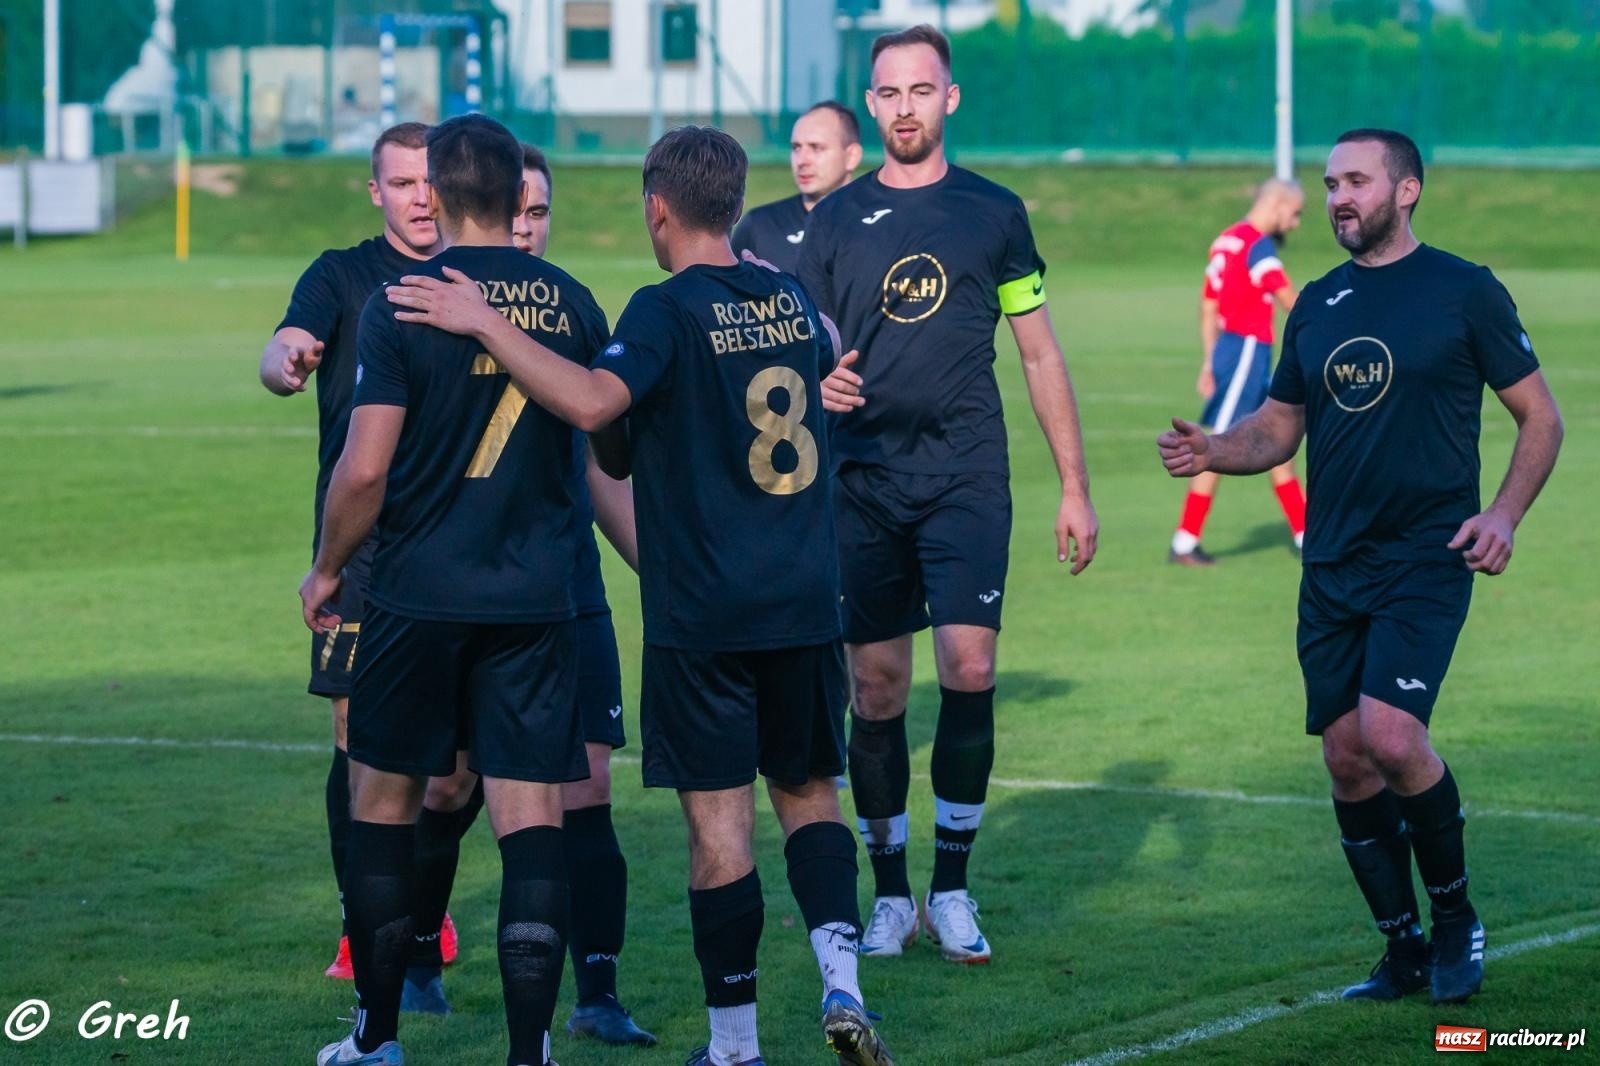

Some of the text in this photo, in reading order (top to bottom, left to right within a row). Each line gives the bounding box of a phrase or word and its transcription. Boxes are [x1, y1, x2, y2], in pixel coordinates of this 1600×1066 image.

[476, 278, 560, 307] OZWÓJ
[891, 277, 938, 298] W&H
[497, 305, 572, 337] ZNICA
[711, 288, 803, 326] ROZWÓJ
[1333, 362, 1384, 384] W&H
[464, 353, 529, 478] 7
[746, 366, 818, 495] 8
